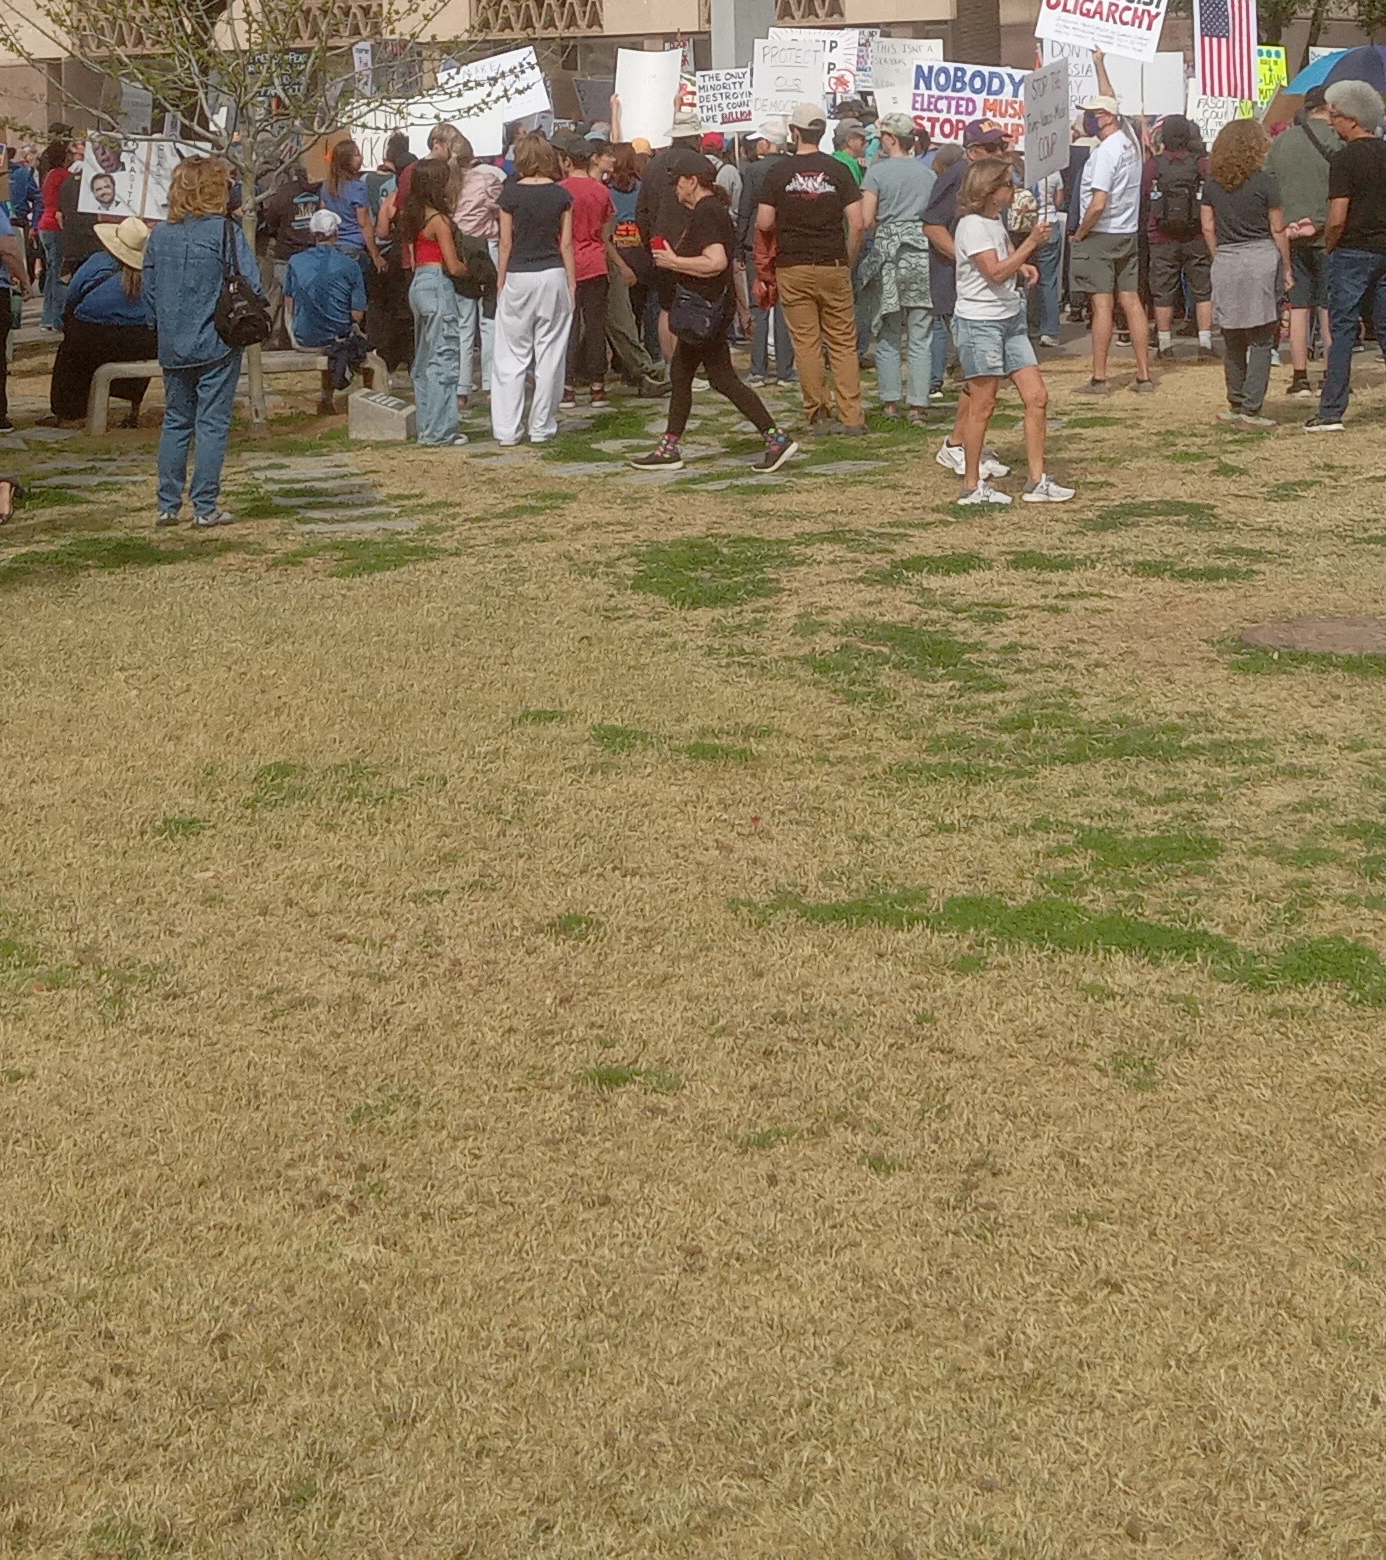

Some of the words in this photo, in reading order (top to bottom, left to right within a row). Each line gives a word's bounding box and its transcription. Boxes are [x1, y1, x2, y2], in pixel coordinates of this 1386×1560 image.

[762, 45, 821, 66] PROTECT
[700, 72, 721, 83] THE
[724, 71, 748, 81] ONLY
[914, 64, 1025, 98] NOBODY
[698, 80, 744, 94] MINORITY
[699, 102, 724, 115] THIS
[912, 93, 977, 116] ELECTED
[700, 114, 718, 124] ARE
[913, 115, 966, 140] STOP
